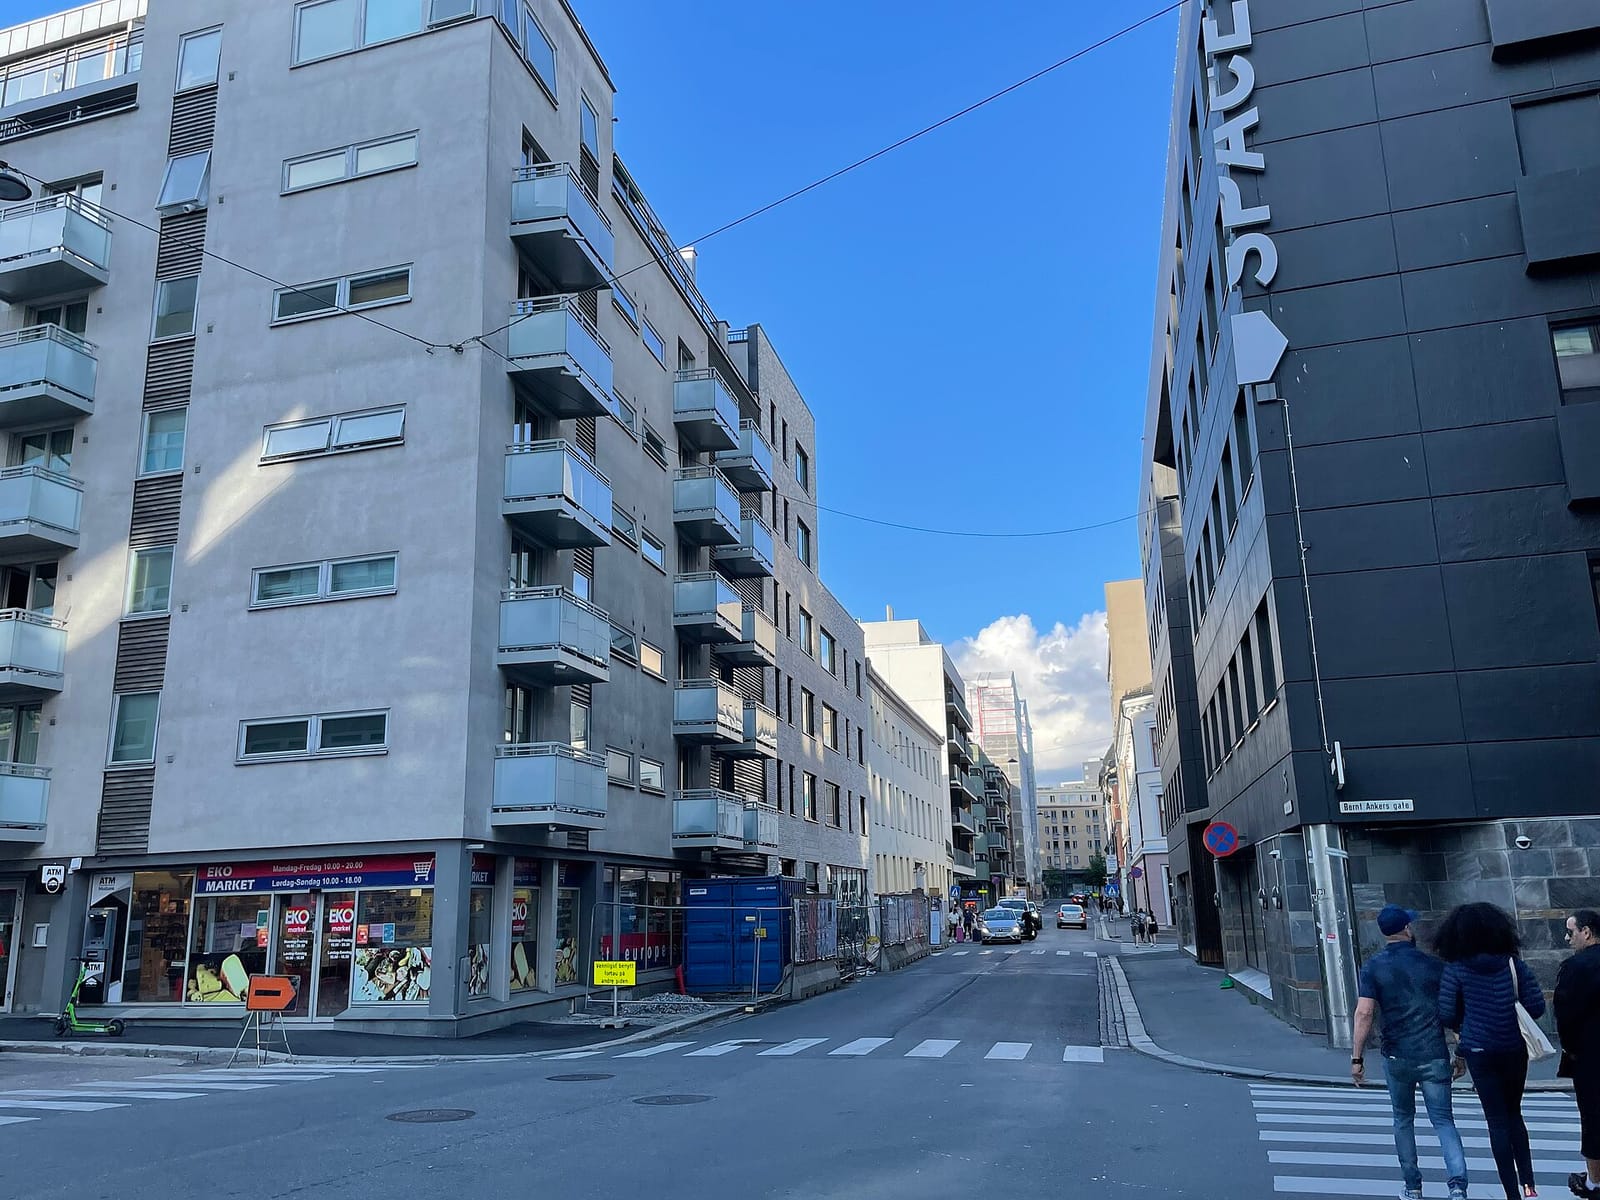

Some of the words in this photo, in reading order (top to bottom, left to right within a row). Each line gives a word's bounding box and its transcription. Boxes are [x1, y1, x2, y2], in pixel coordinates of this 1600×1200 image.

[1202, 0, 1278, 288] SPACE
[1343, 802, 1362, 811] Bernt
[1366, 802, 1389, 810] Ankers
[1393, 802, 1409, 811] gate
[46, 868, 62, 876] ATM
[207, 866, 233, 878] EKO
[472, 872, 489, 882] RKET
[99, 876, 115, 884] ATM
[206, 880, 256, 891] MARKET
[285, 909, 310, 924] EKO
[329, 908, 354, 923] EKO
[624, 944, 667, 963] europe
